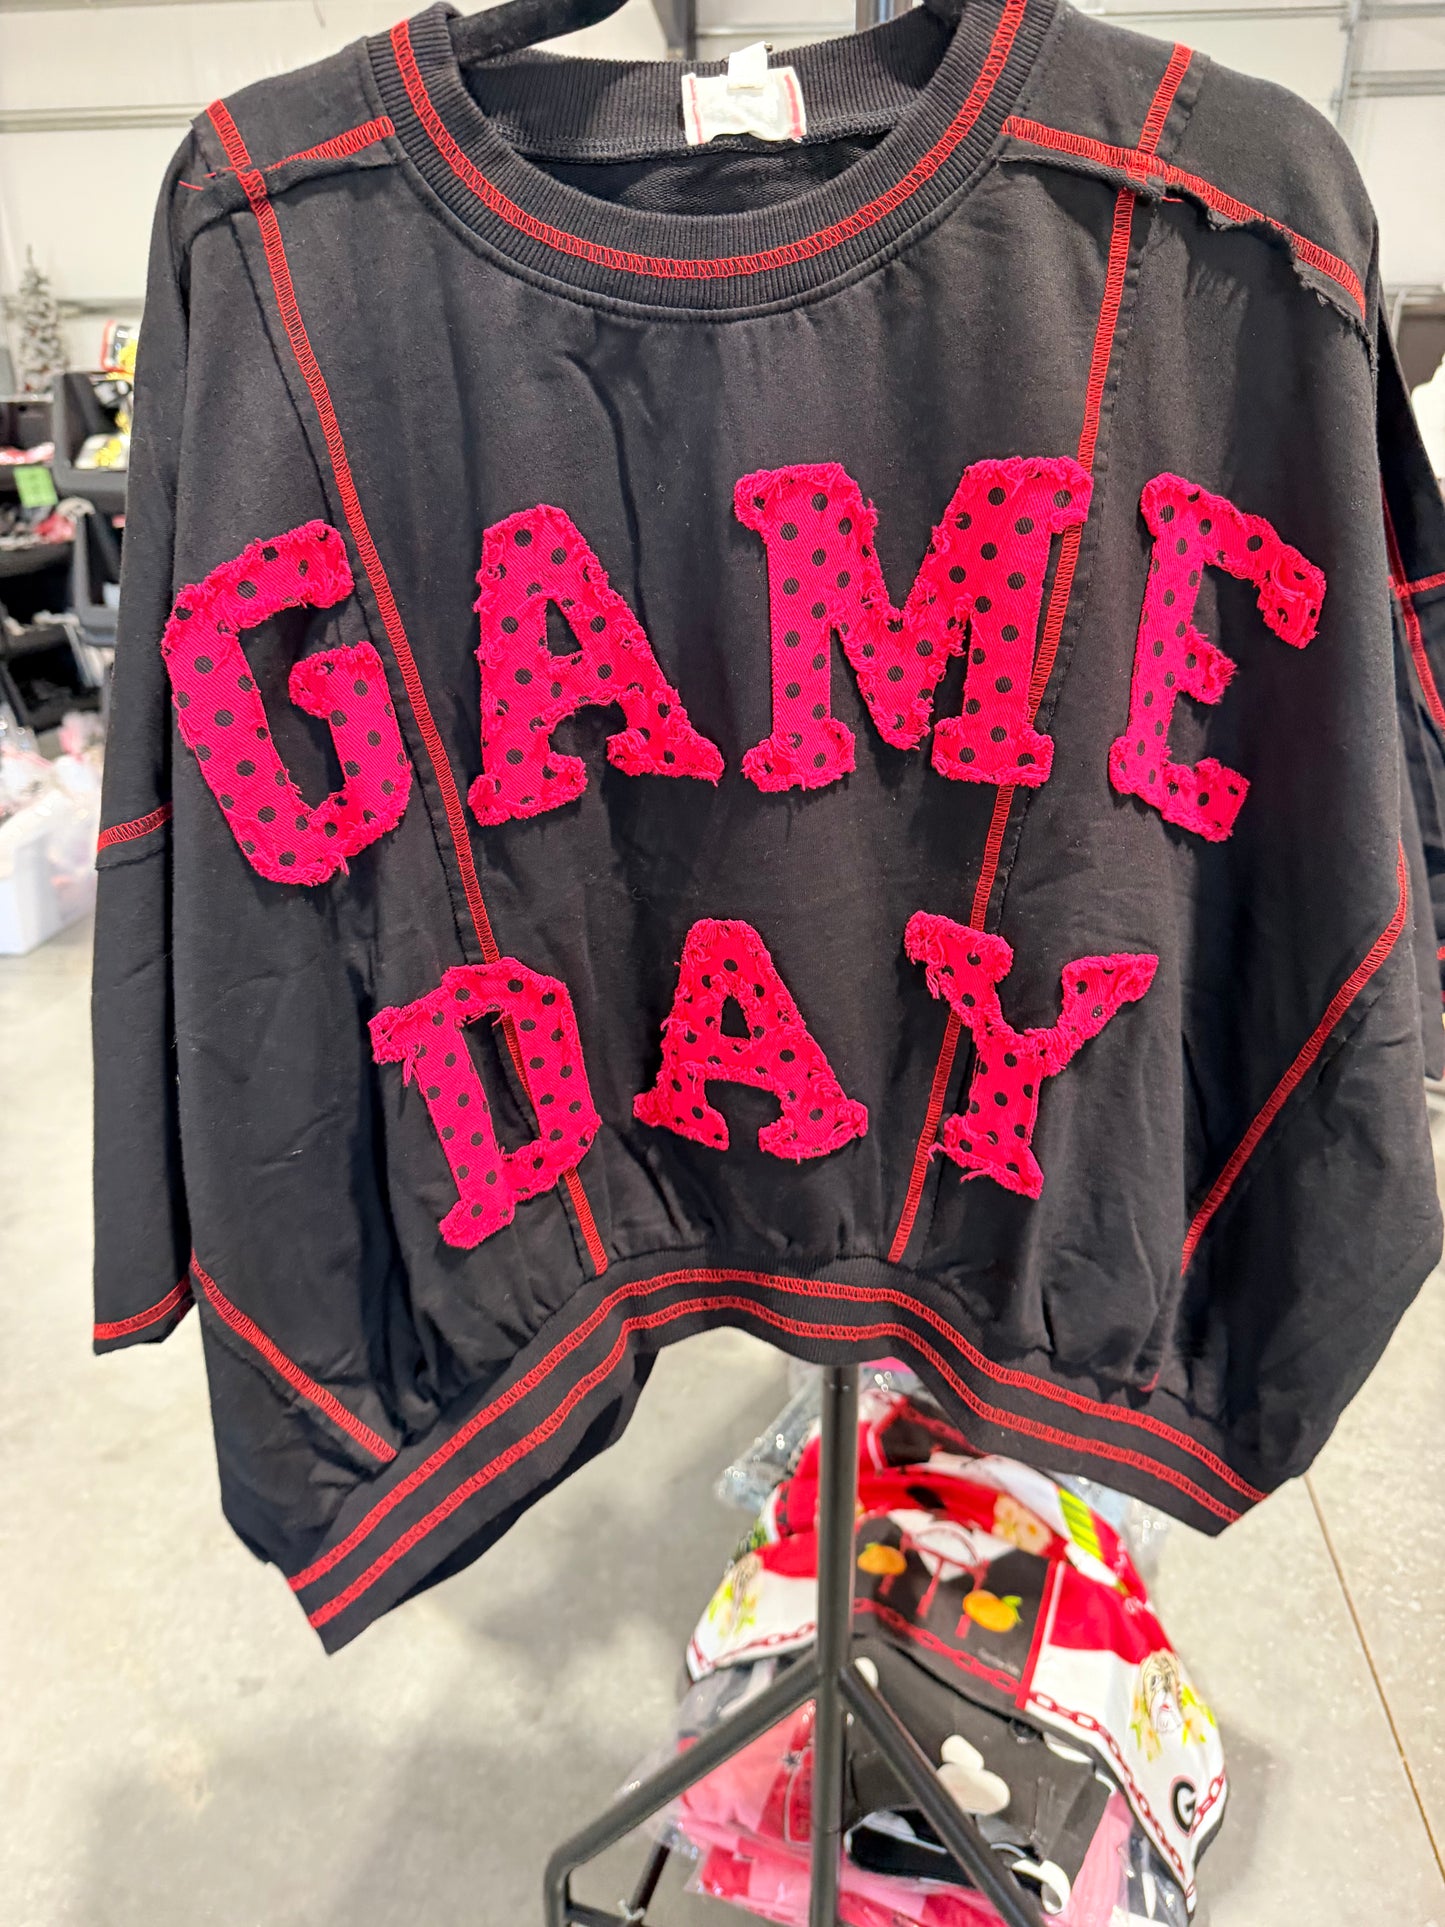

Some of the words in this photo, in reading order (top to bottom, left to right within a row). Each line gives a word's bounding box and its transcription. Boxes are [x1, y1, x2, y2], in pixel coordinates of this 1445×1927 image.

[162, 457, 1327, 886] GAME
[369, 911, 1158, 1250] DAY
[1169, 1776, 1198, 1836] G
